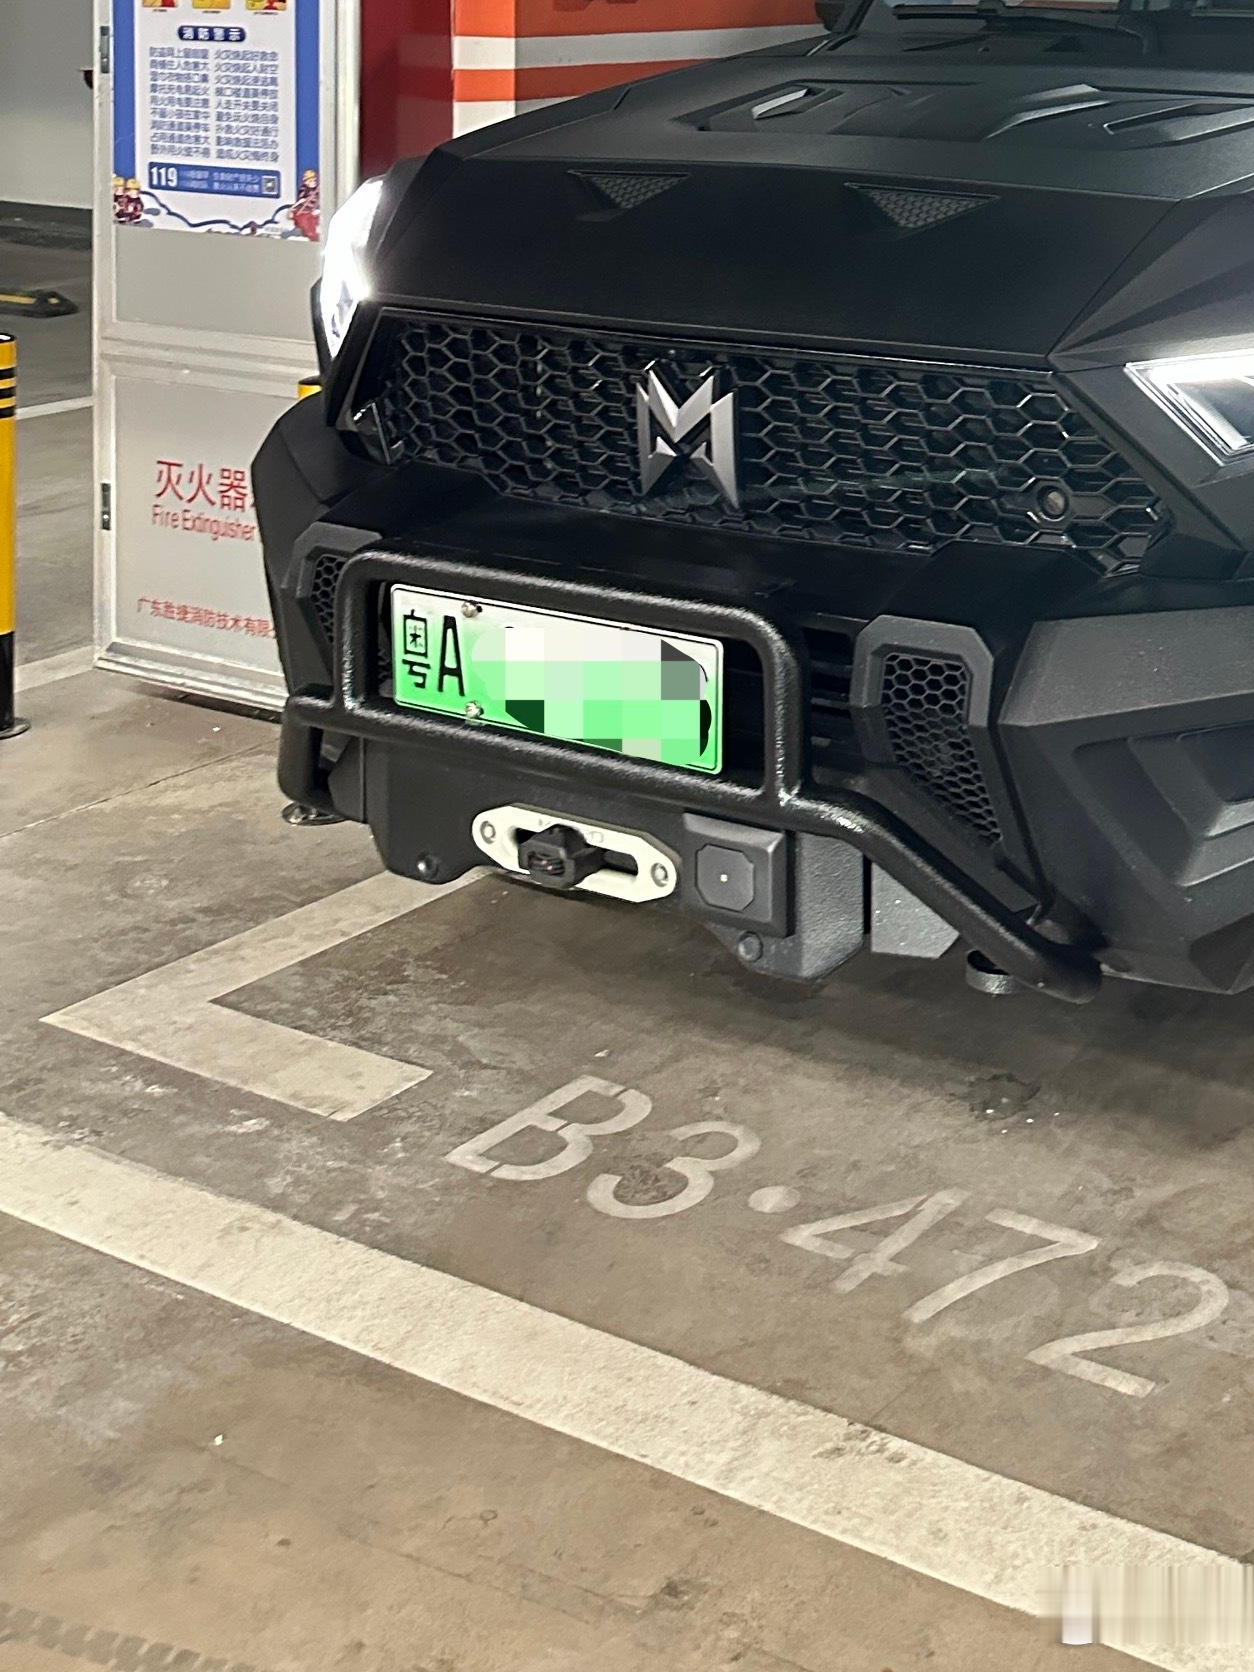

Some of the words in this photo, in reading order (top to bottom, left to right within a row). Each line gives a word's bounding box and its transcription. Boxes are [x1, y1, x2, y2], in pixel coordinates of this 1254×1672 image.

[150, 167, 178, 187] 119
[155, 459, 254, 513] 灭火器
[151, 503, 180, 529] Fire
